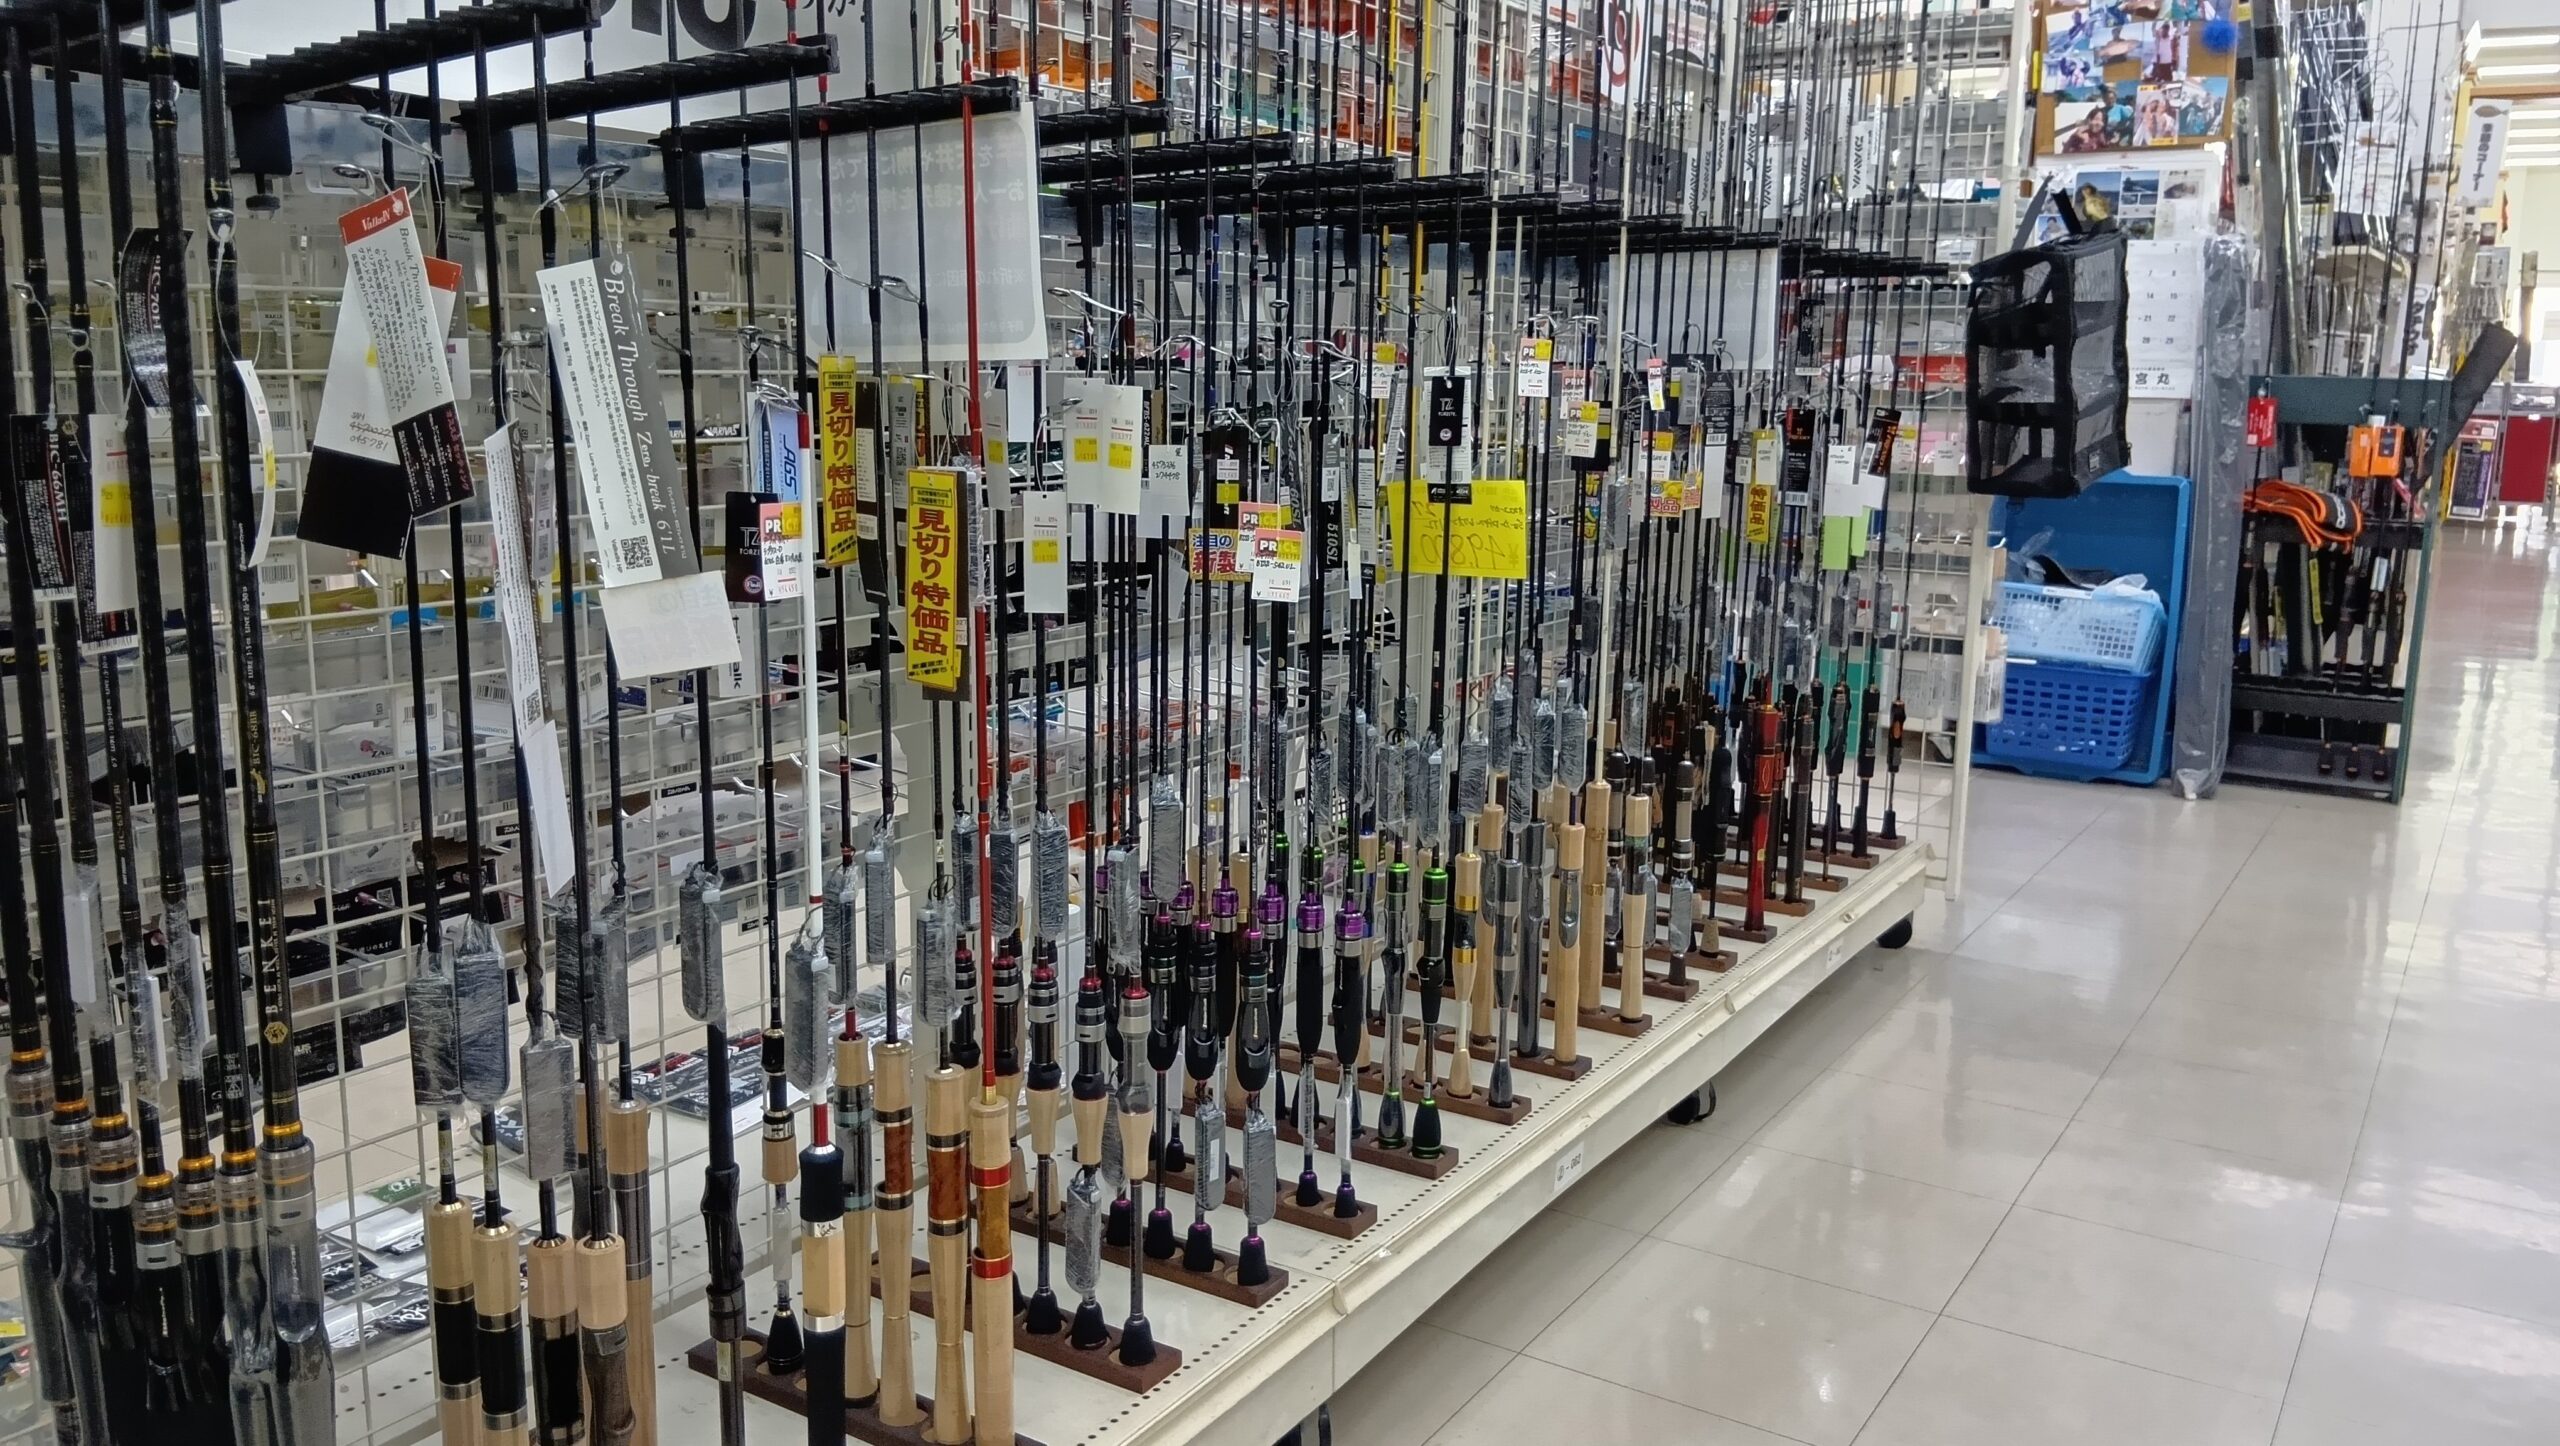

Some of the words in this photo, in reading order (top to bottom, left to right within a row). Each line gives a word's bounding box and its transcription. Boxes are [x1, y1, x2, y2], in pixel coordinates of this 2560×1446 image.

[1852, 135, 1864, 189] DAIWA
[150, 255, 162, 329] IC-70H
[399, 227, 414, 262] Break
[409, 264, 425, 312] Through
[603, 277, 630, 336] Break
[617, 340, 649, 422] Through
[1565, 377, 1585, 385] PRIC
[48, 433, 69, 521] BIC-66MH
[783, 434, 797, 495] AGS
[826, 391, 857, 534] 見切り特価品
[1750, 486, 1767, 526] 特価品
[1192, 550, 1238, 574] 新製
[1326, 522, 1339, 566] 510SL
[911, 507, 950, 657] 見切り特価品
[474, 724, 508, 735] SHIMANO
[666, 785, 691, 795] DAIWA
